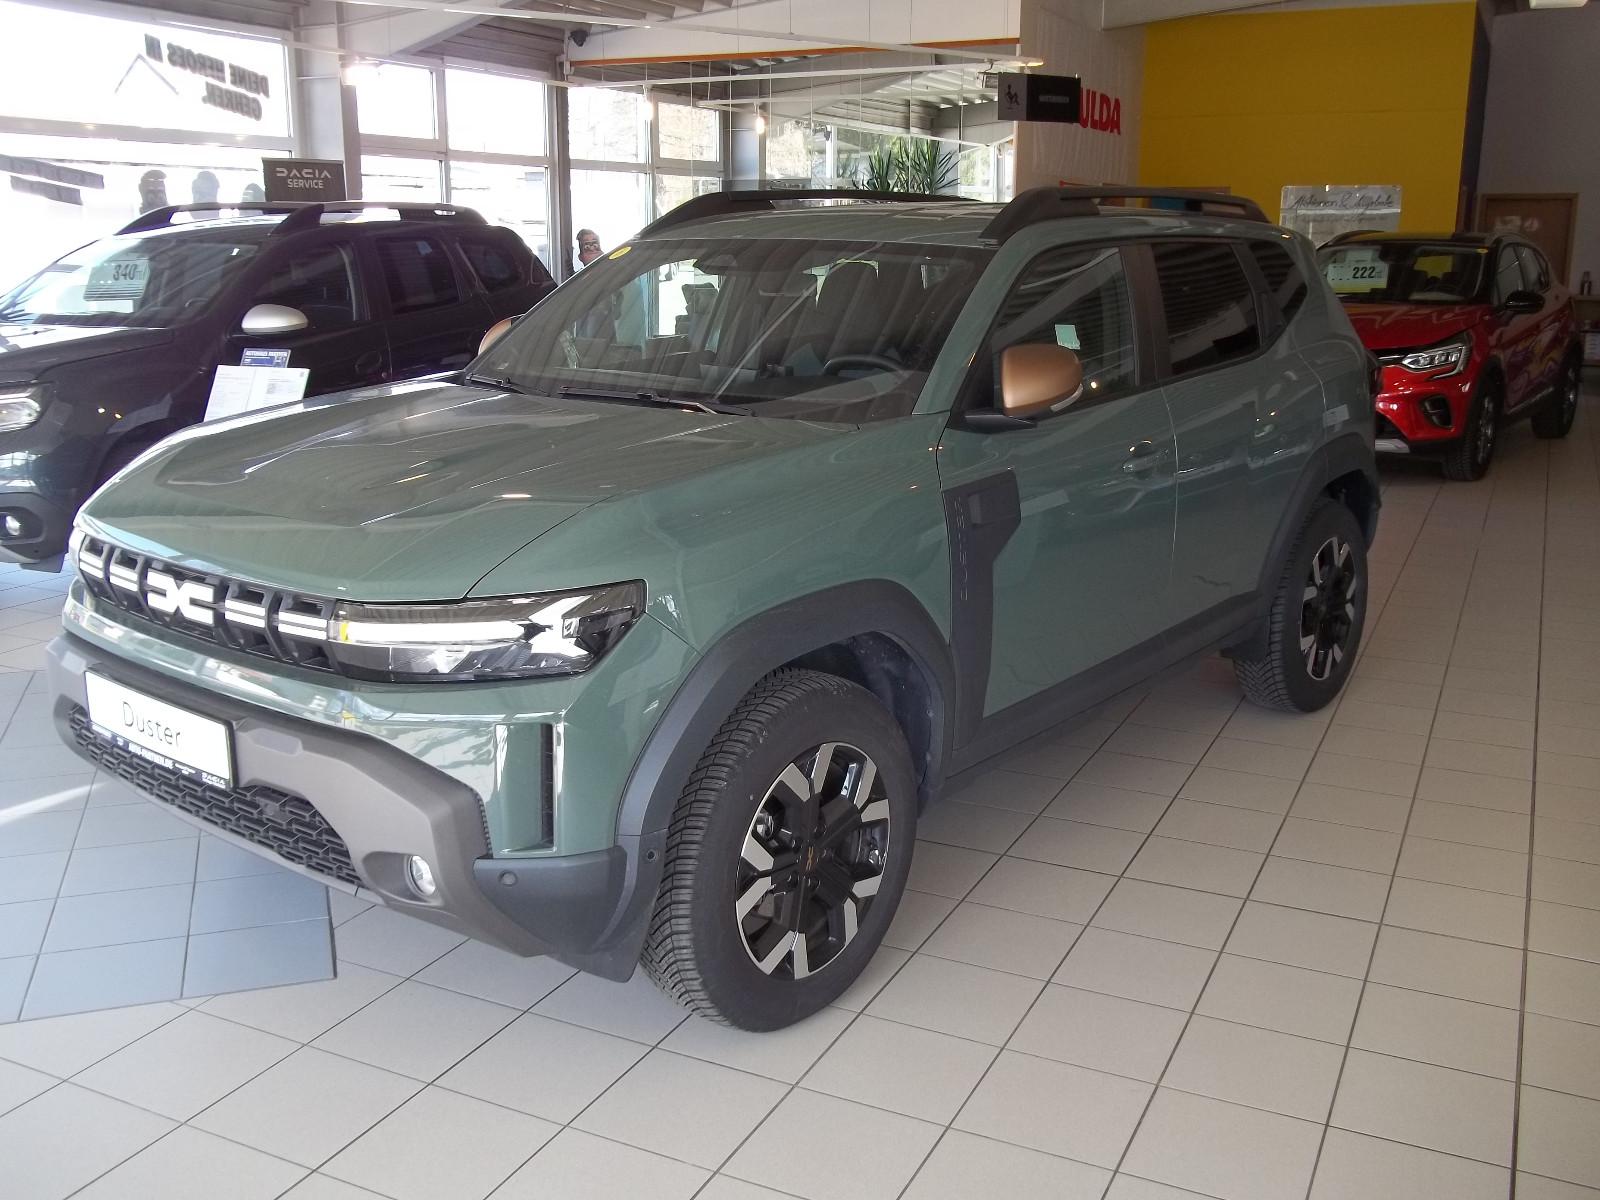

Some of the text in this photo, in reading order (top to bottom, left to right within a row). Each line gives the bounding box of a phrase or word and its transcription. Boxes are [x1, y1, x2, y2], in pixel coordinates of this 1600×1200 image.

[1080, 87, 1121, 135] ULDA
[274, 167, 331, 179] DACIA
[287, 179, 324, 189] SERVICE
[113, 263, 138, 281] 340
[1352, 266, 1376, 279] 222
[122, 701, 181, 746] Duster
